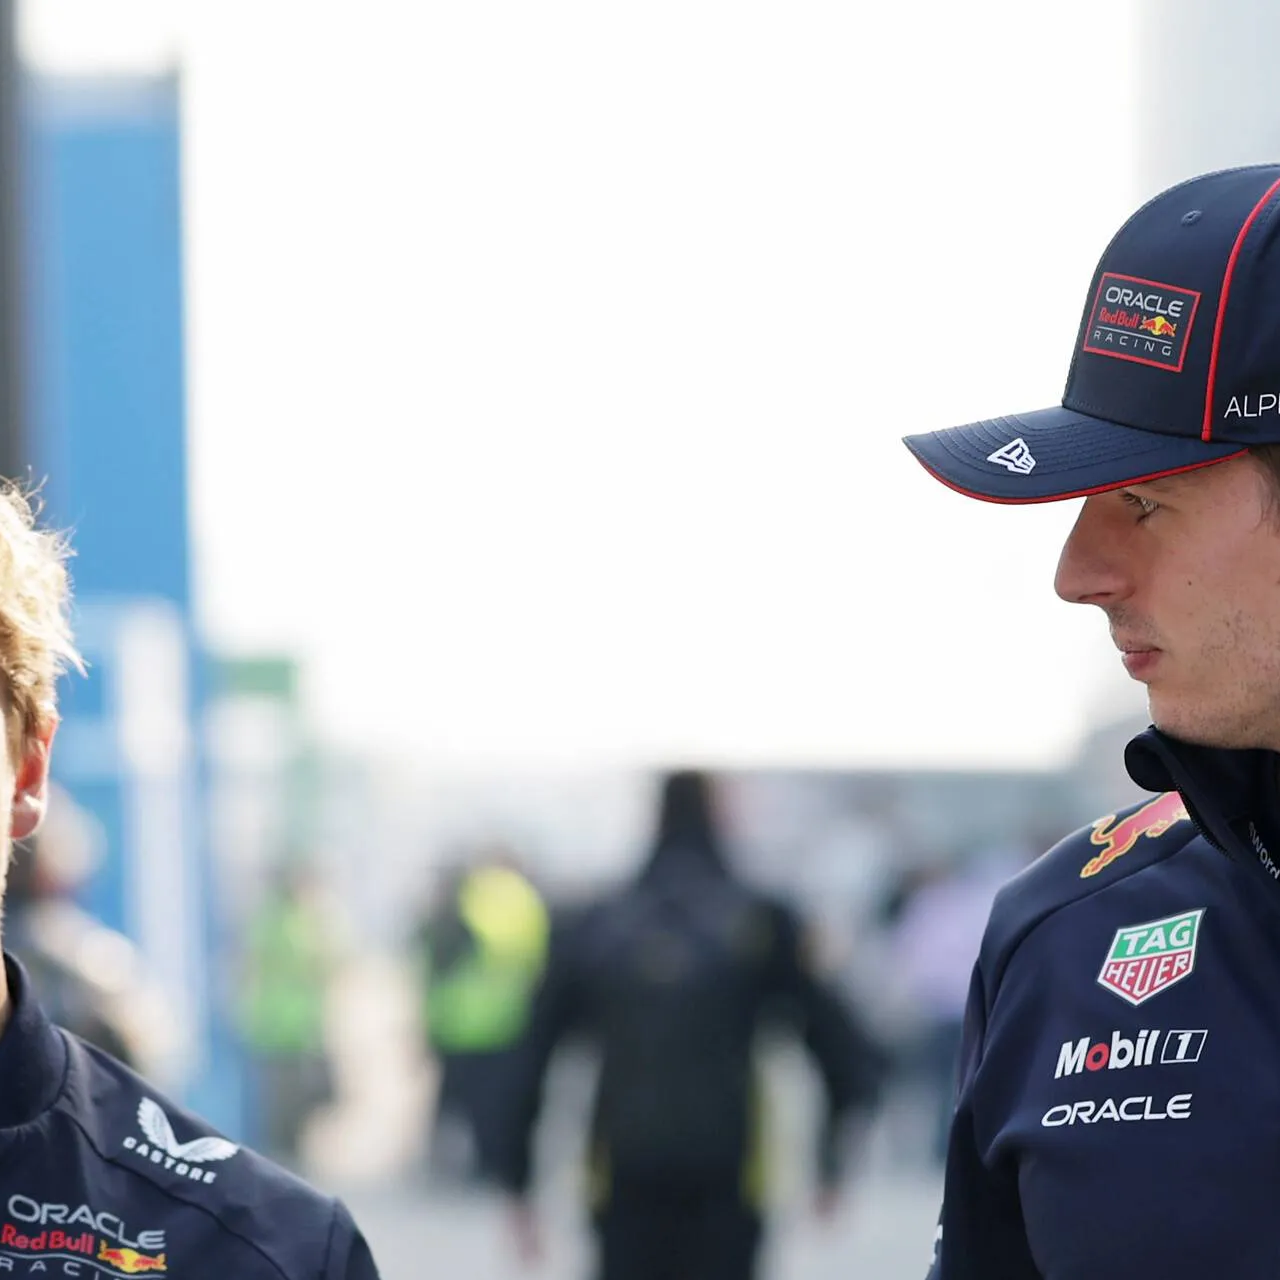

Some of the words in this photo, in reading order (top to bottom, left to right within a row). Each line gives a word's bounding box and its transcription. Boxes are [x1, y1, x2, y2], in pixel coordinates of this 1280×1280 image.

[1098, 306, 1119, 324] Red
[1117, 309, 1140, 328] Bull
[1105, 286, 1184, 318] ORACLE
[1093, 330, 1172, 357] RACING
[1123, 919, 1192, 956] TAG
[1106, 954, 1190, 996] HEUER
[1054, 1029, 1161, 1079] Mobil
[1041, 1093, 1193, 1127] ORACLE
[122, 1136, 218, 1185] CASTORE
[0, 1224, 48, 1251] Red
[48, 1230, 96, 1255] Bull
[7, 1194, 167, 1250] ORACLE
